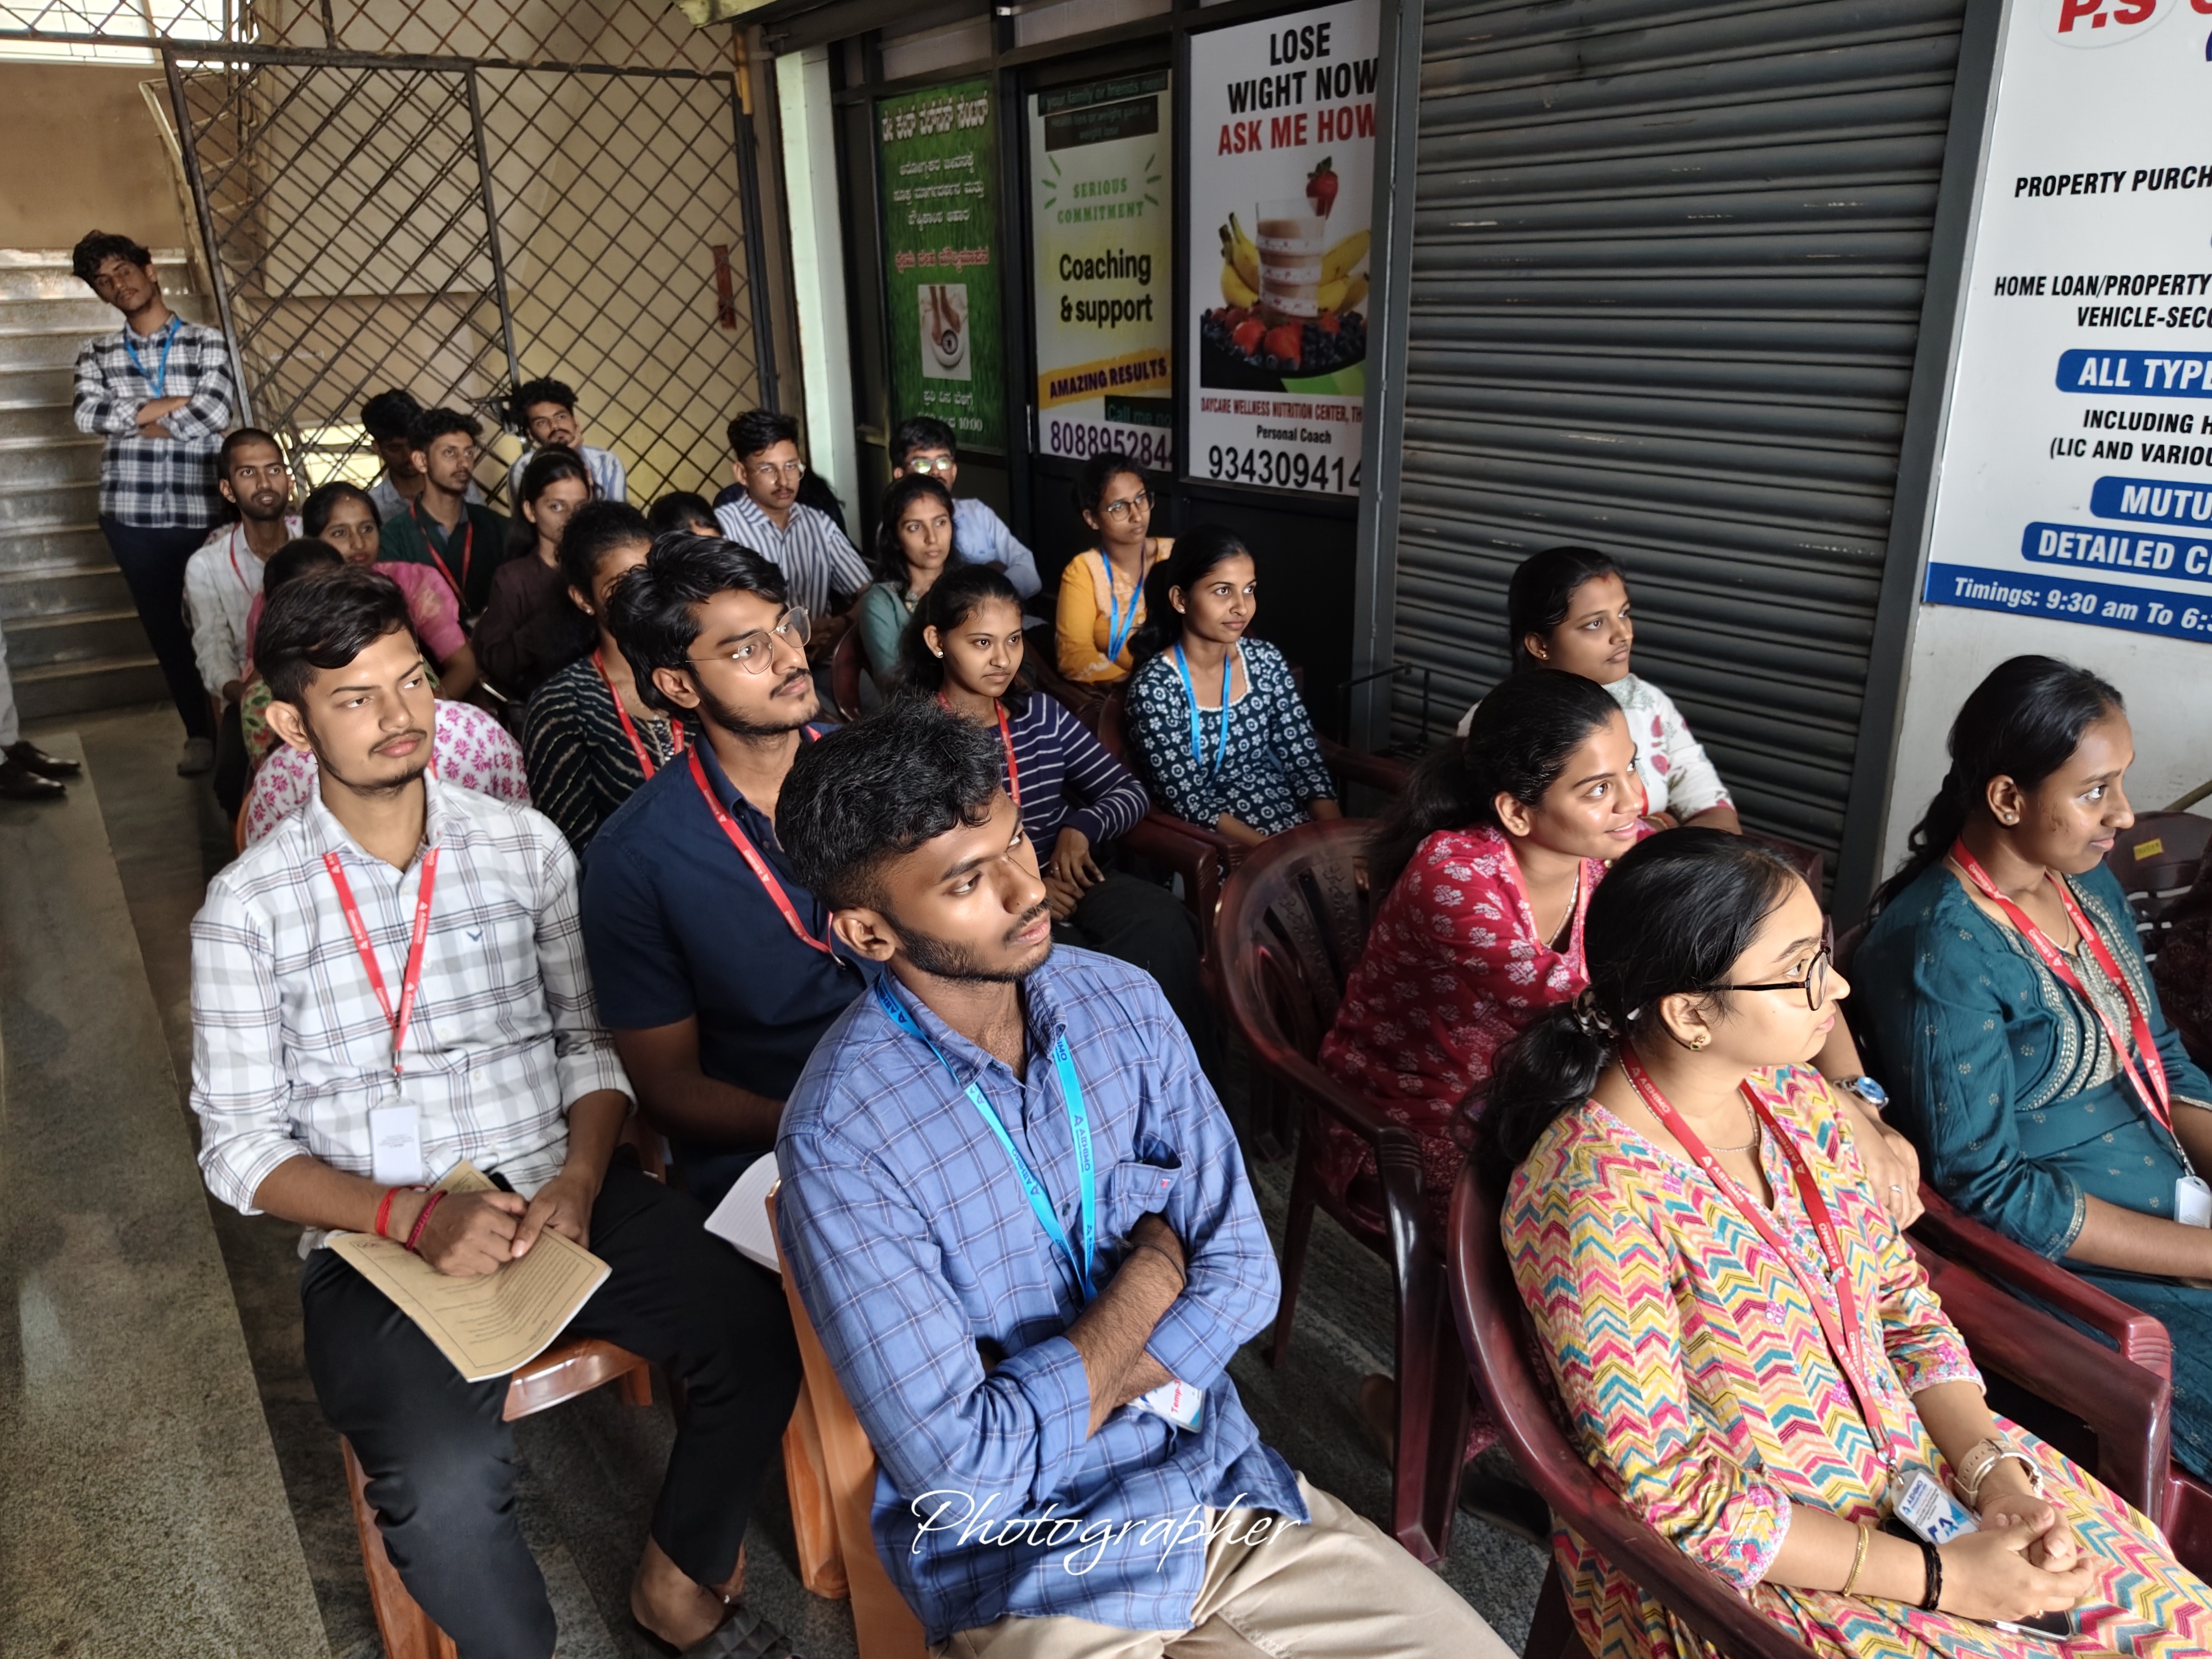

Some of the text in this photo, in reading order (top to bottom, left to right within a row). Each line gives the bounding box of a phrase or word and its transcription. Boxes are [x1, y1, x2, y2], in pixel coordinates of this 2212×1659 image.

[1270, 22, 1331, 66] LOSE
[1228, 57, 1378, 114] WIGHT NOW
[1218, 103, 1375, 156] ASK ME HOW
[1073, 177, 1127, 199] SERIOUS
[2014, 165, 2212, 198] PROPERTY PURCH
[1057, 200, 1144, 224] COMMITMENT
[1060, 248, 1152, 286] Coaching
[1994, 273, 2212, 298] HOME LOAN/PROPERTY
[1061, 293, 1154, 329] & support
[1050, 356, 1168, 399] AMAZING RESULTS
[2078, 357, 2131, 388] ALL
[1107, 403, 1130, 422] Call
[1133, 410, 1152, 425] me
[1201, 397, 1231, 414] DAYCARE
[1233, 399, 1271, 416] WELLNESS
[1272, 401, 1313, 420] NUTRITION
[2083, 409, 2194, 434] INCLUDING
[1051, 420, 1171, 470] 808895284
[1257, 424, 1332, 444] Personal Coach
[2050, 437, 2087, 459] (LIC
[2092, 441, 2133, 460] AND
[1209, 444, 1361, 493] 934309414
[2120, 484, 2212, 521] MUTU
[2038, 529, 2175, 571] DETAILED
[1954, 577, 2040, 609] Timings:
[2046, 589, 2098, 615] 9:30
[2101, 600, 2139, 621] am
[2147, 602, 2173, 626] To
[1639, 1077, 1671, 1114] ABHIMO
[1079, 1128, 1091, 1171] ABHIMO
[1712, 1166, 1745, 1202] ABHIMO
[1818, 1222, 1839, 1264] ABHIMO
